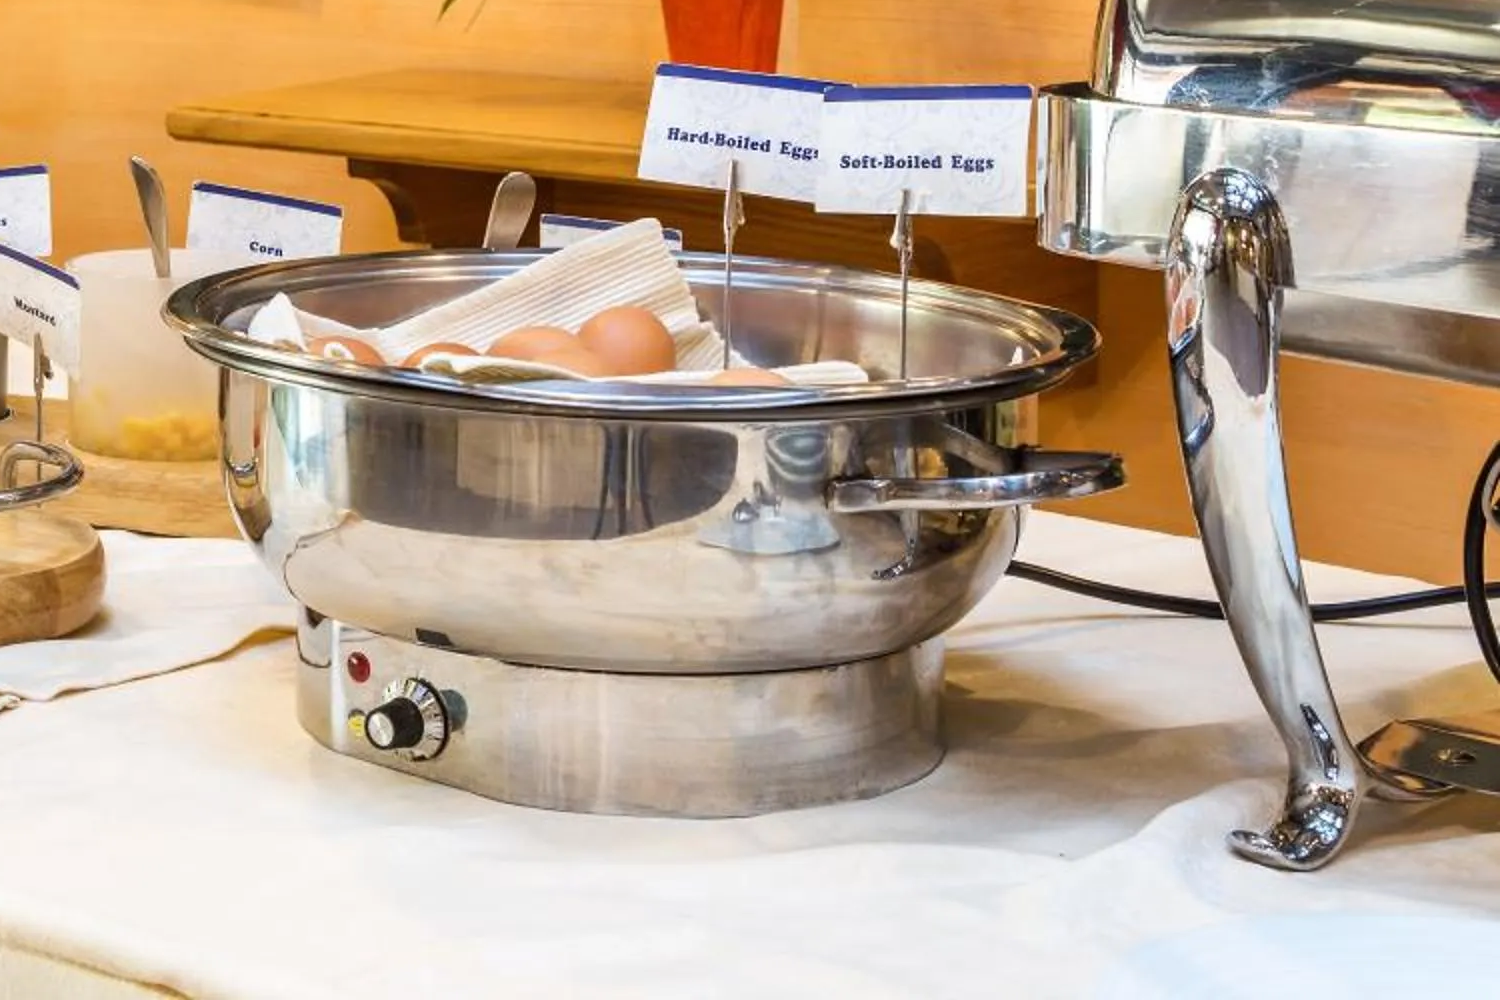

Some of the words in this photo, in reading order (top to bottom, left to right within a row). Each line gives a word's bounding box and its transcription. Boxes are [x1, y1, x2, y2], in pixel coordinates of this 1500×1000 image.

[666, 126, 771, 153] Hard-Boiled
[839, 154, 942, 169] Soft-Boiled
[951, 154, 995, 173] Eggs
[249, 240, 284, 257] Corn
